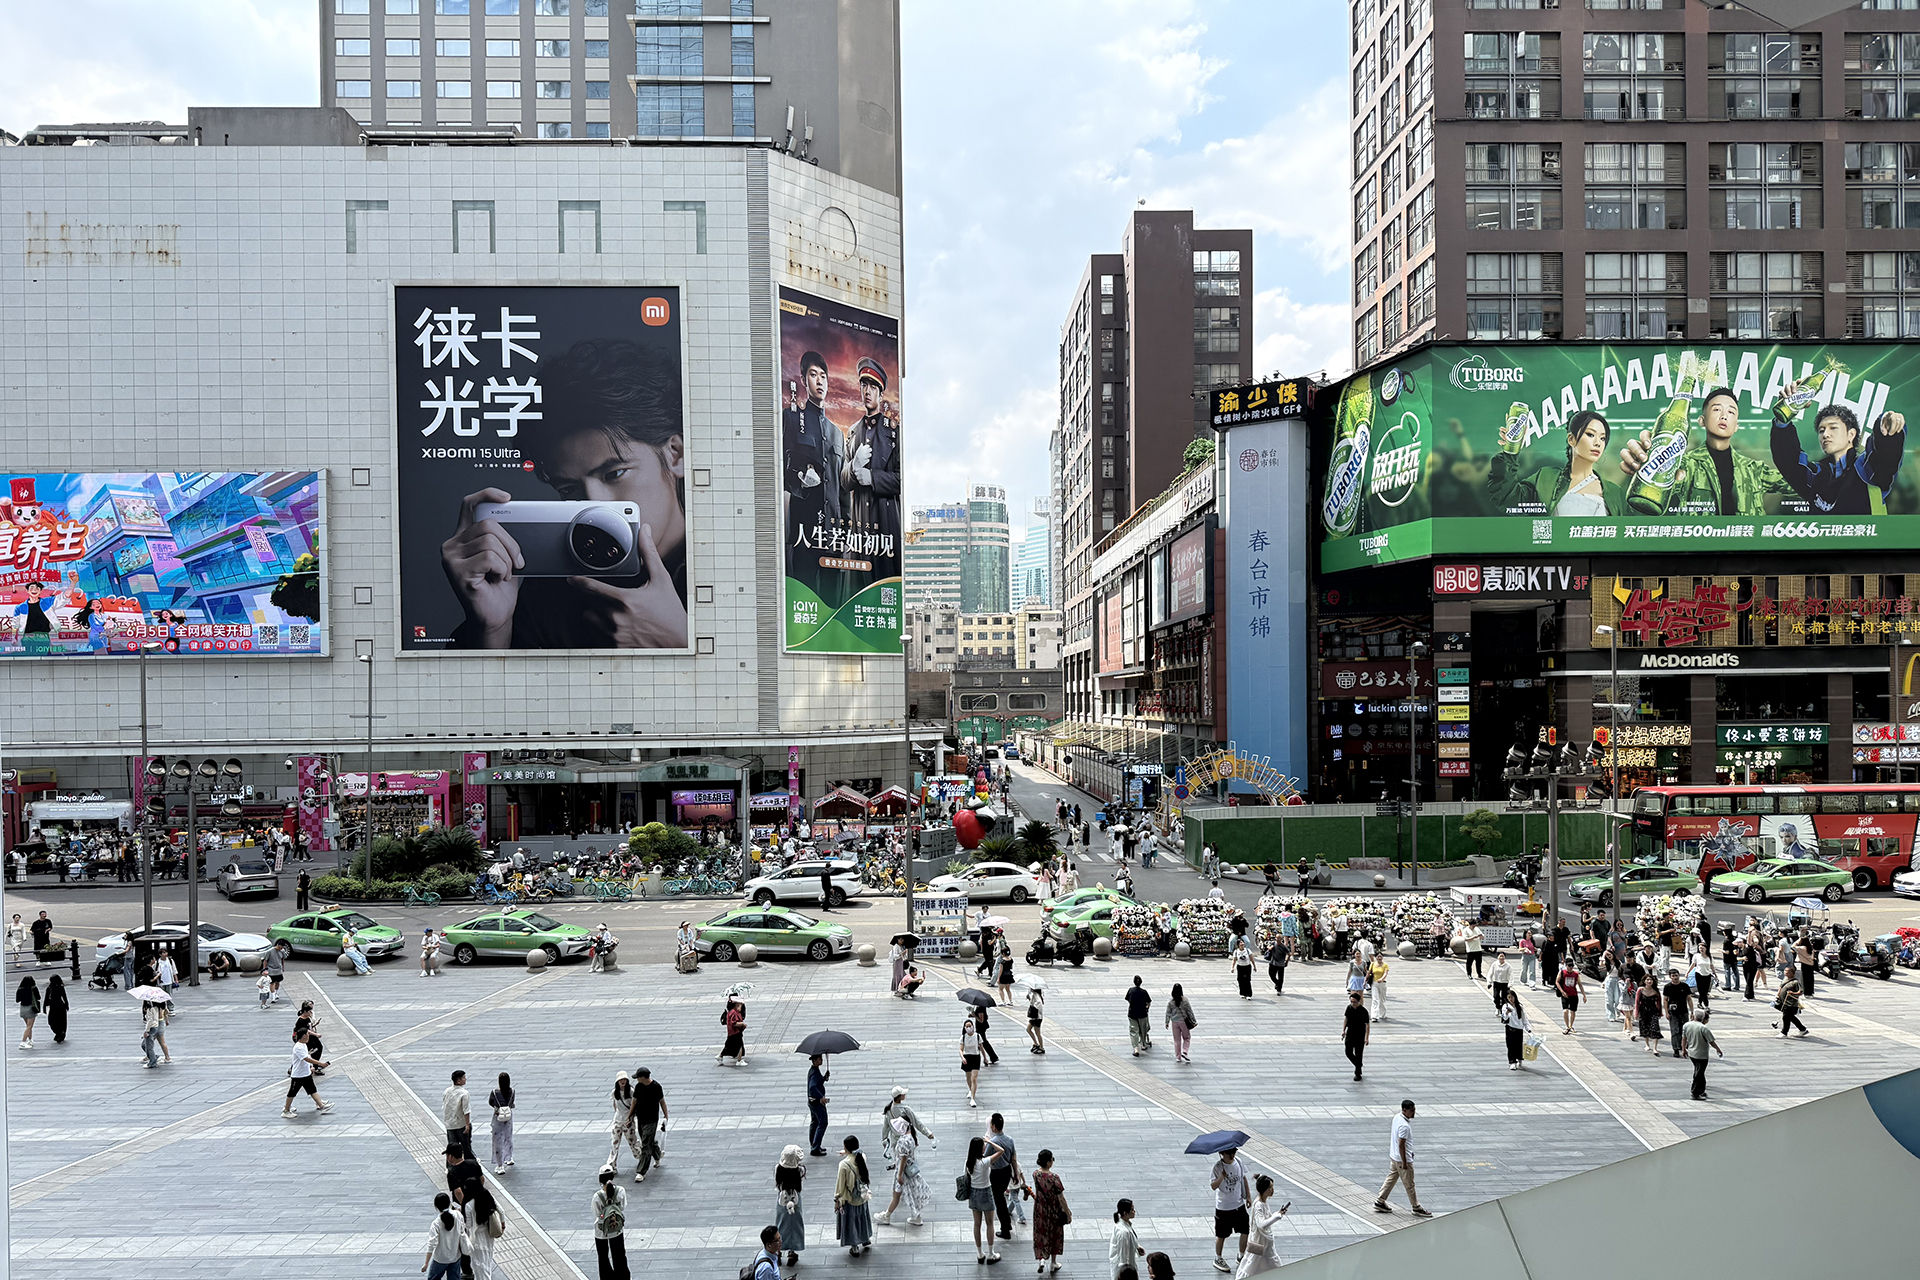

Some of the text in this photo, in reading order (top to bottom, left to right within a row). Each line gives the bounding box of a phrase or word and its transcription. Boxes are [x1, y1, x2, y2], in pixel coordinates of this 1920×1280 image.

[413, 306, 541, 369] 徕卡
[1461, 367, 1524, 383] TUBORG
[1219, 382, 1298, 413] 渝少侠
[420, 376, 543, 437] 光学
[1283, 405, 1296, 415] 6F
[480, 448, 491, 458] 15
[494, 447, 521, 459] Ultra
[1641, 441, 1679, 477] TUBORG
[1325, 450, 1362, 520] TUBORG
[1371, 468, 1419, 495] WHY NOT!
[1569, 525, 1617, 538] 拉盖扫码
[1761, 521, 1878, 538] 赢6666元现金豪礼
[793, 523, 895, 558] 人生若如初见
[1359, 534, 1389, 551] TUBORG
[1247, 528, 1271, 639] 春台市锦
[1436, 565, 1589, 592] 唱吧 麦颂KTV 3F
[793, 601, 818, 612] iQIYI
[1756, 595, 1920, 617] 来成都必吃的串
[793, 613, 818, 625] 爱奇艺
[854, 615, 897, 630] 正在热播
[126, 624, 251, 638] 6月5日 全网爆笑开播
[1790, 620, 1920, 635] 成都鲜牛肉老串串
[189, 640, 251, 651] 健康中国行
[1640, 653, 1740, 668] McDonald's
[1368, 703, 1396, 713] luckin
[503, 770, 556, 780] 美美时尚馆
[79, 793, 106, 803] gelato
[912, 899, 936, 910] 打柠檬茶
